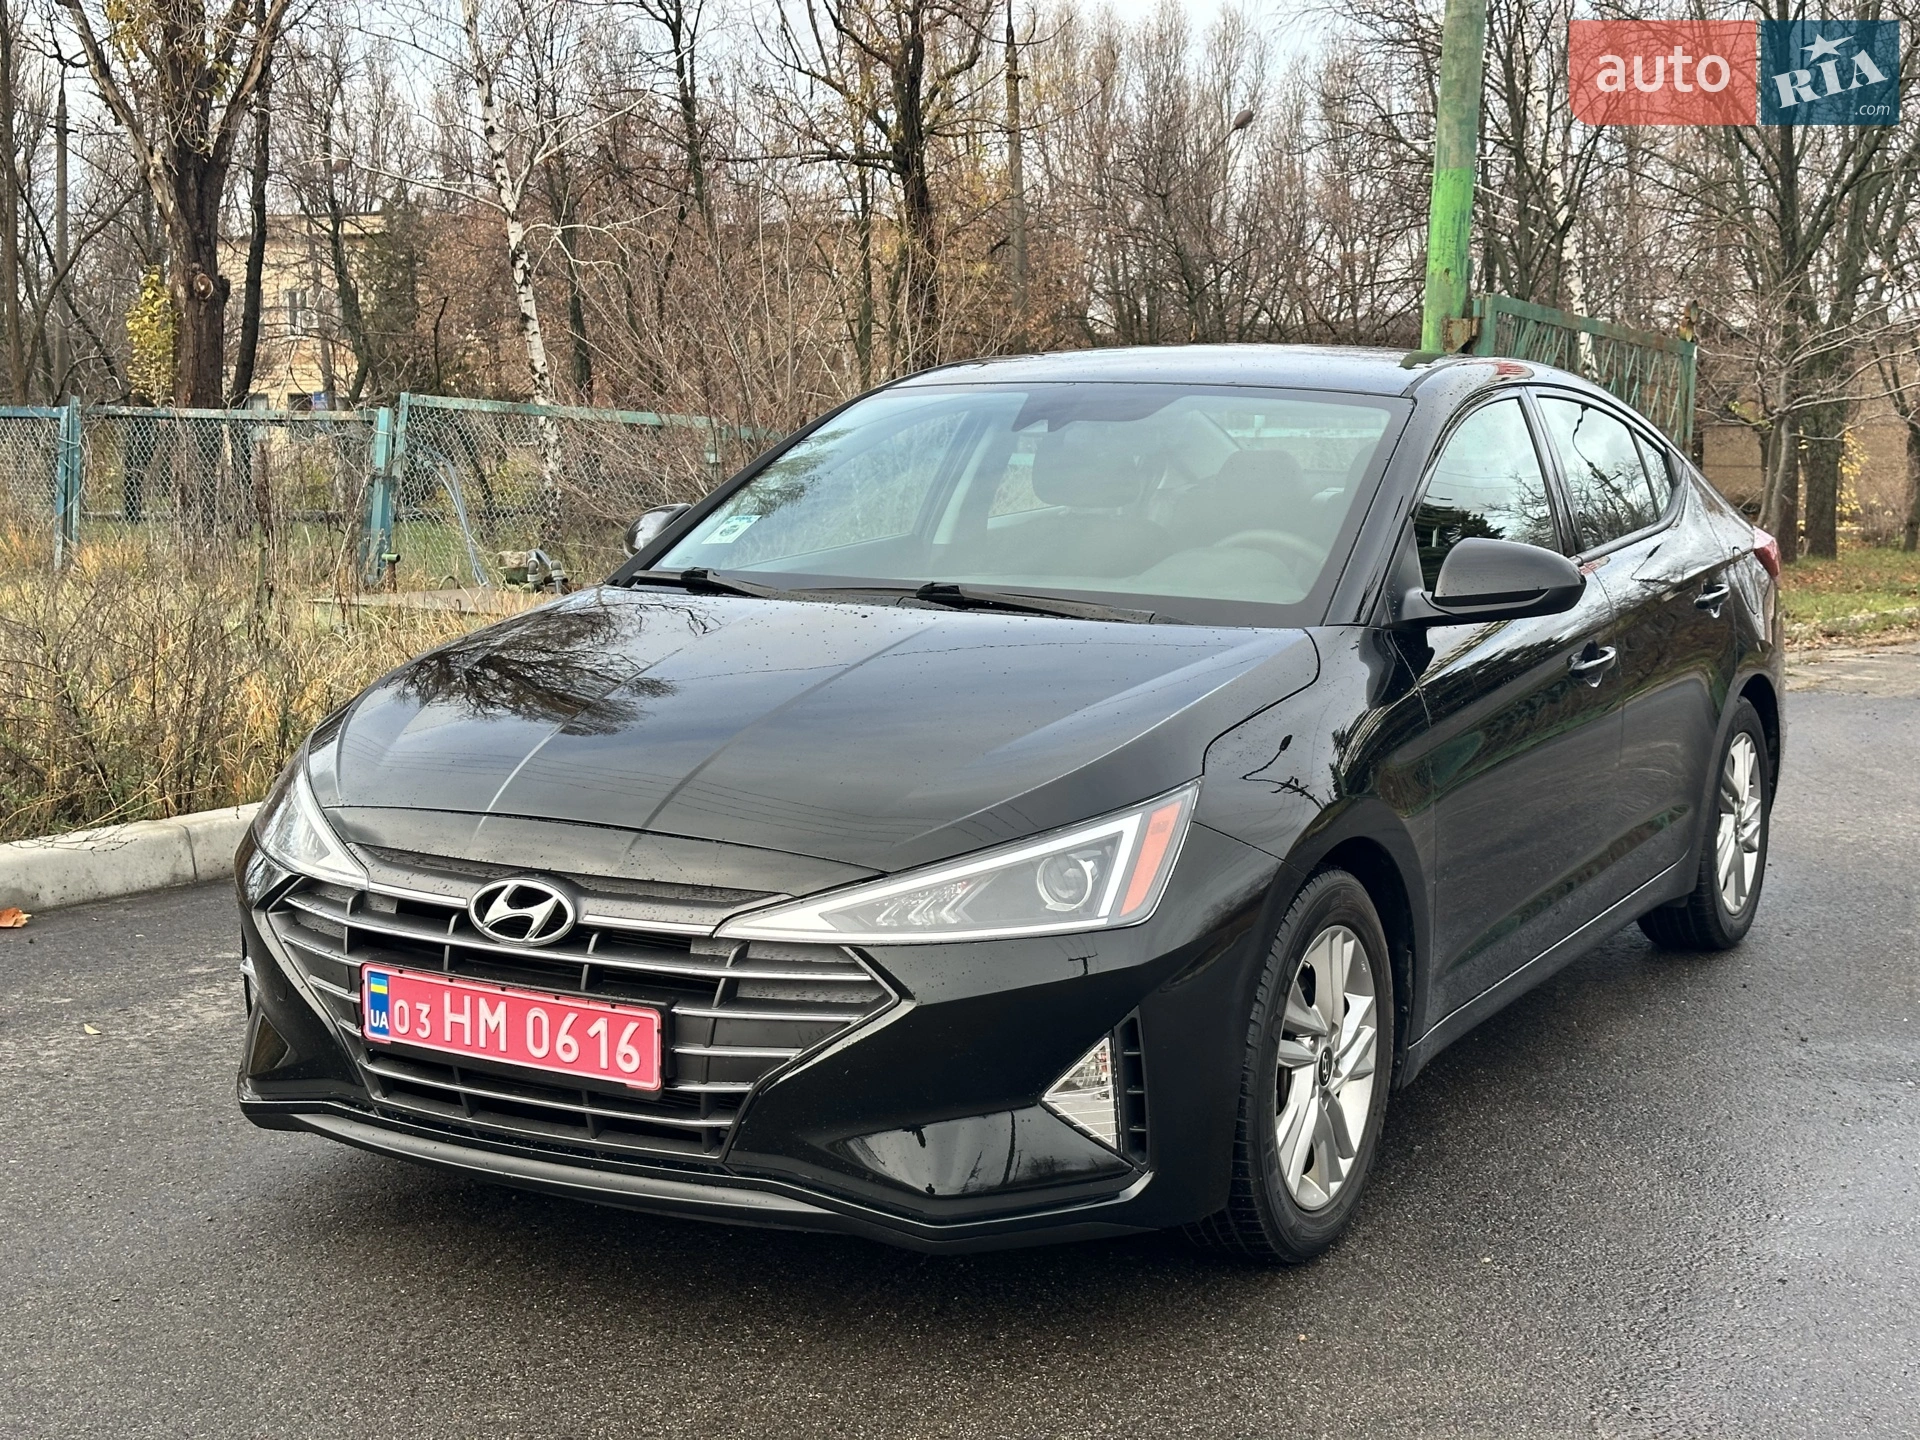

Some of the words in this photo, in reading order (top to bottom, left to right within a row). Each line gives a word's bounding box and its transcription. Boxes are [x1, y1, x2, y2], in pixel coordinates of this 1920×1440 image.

[370, 1009, 389, 1029] UA
[393, 999, 431, 1039] 03
[443, 991, 507, 1052] HM
[526, 1007, 641, 1073] 0616
